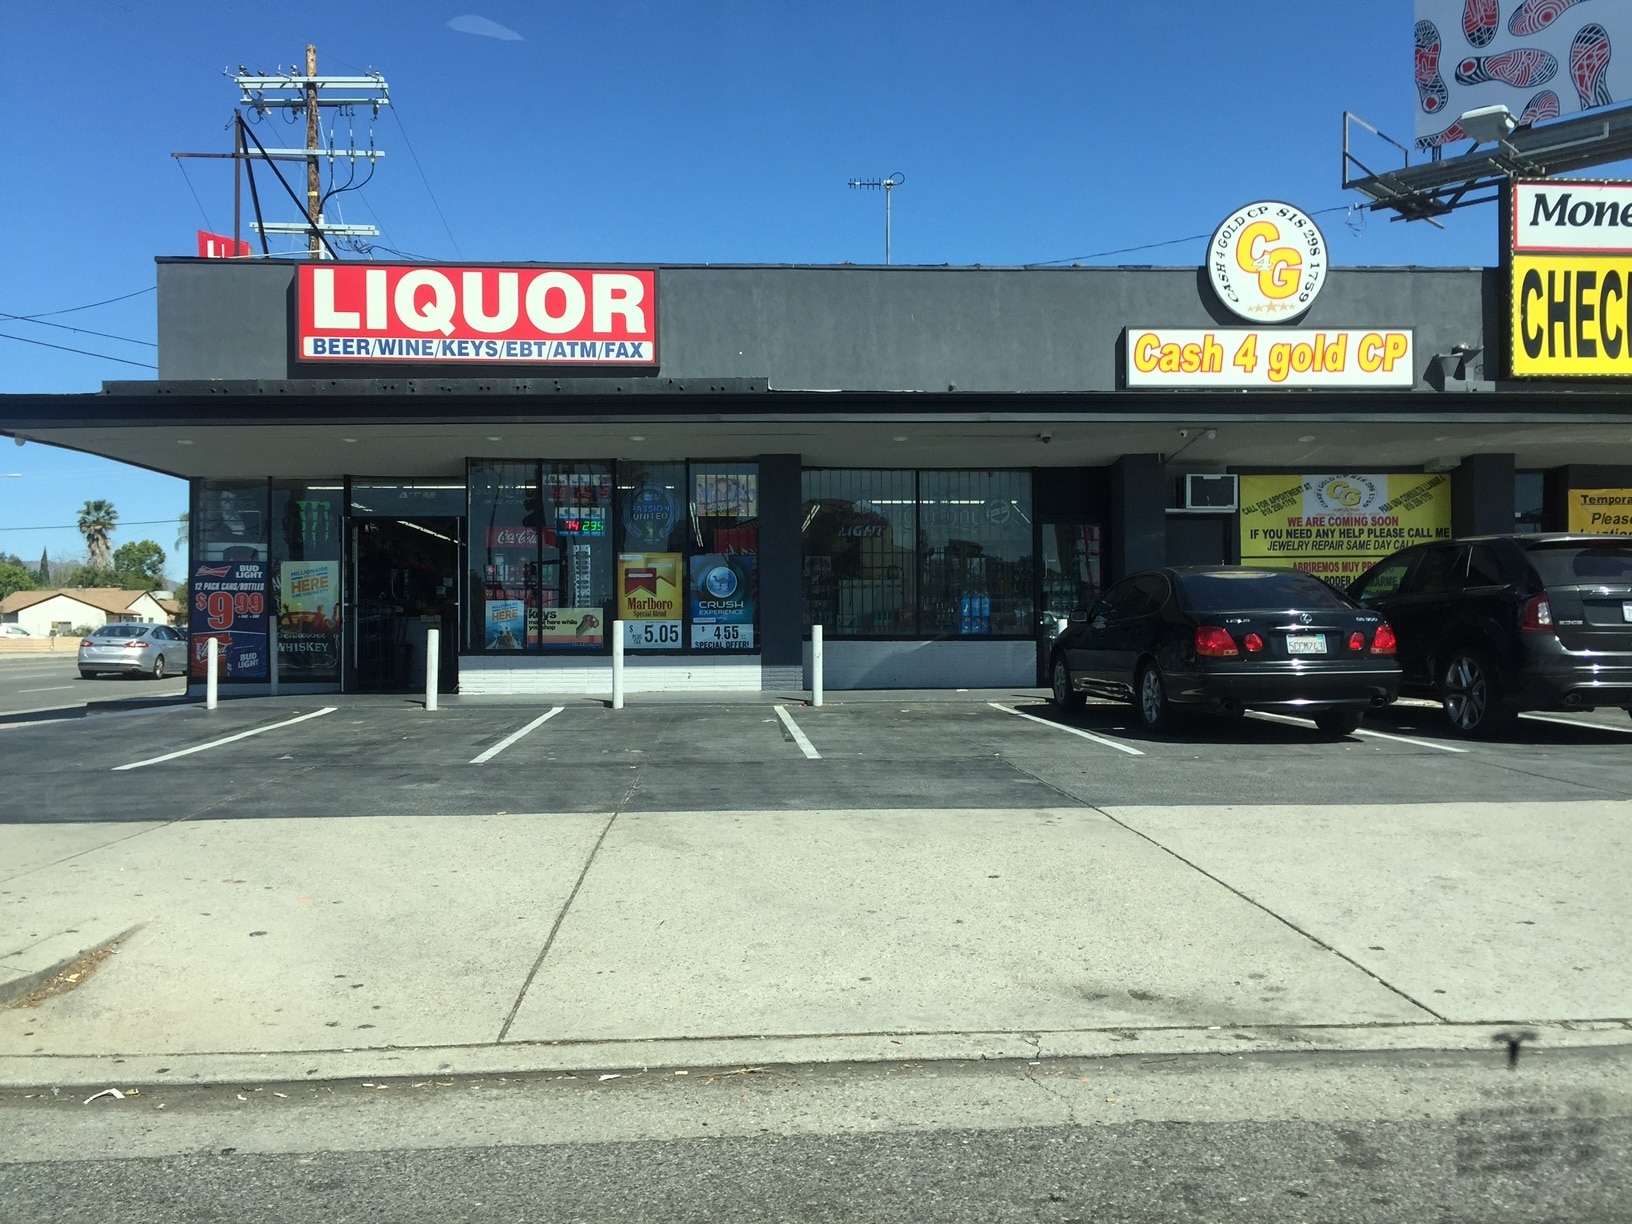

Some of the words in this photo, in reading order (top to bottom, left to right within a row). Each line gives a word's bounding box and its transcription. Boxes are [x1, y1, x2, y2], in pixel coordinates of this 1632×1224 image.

[1247, 206, 1268, 218] CP
[1218, 216, 1245, 248] GOLD
[1216, 250, 1225, 259] 4
[1216, 261, 1239, 302] CASH
[1299, 262, 1320, 302] 1759
[313, 268, 647, 336] LIQUOR
[1521, 268, 1632, 359] CHEC
[1134, 333, 1224, 372] Cash
[1233, 334, 1258, 372] 4
[1268, 333, 1348, 382] gold
[1357, 333, 1408, 372] CP
[1242, 505, 1258, 515] CALL
[1256, 500, 1270, 510] FOR
[1303, 482, 1312, 491] AT
[1287, 517, 1303, 527] WE
[1305, 516, 1325, 527] ARE
[1328, 516, 1369, 527] COMING
[1371, 516, 1399, 526] SOON
[1250, 529, 1259, 539] IF
[1262, 528, 1283, 539] YOU
[1286, 528, 1312, 539] NEED
[1315, 528, 1336, 538] ANY
[1339, 528, 1364, 538] HELP
[1367, 528, 1405, 538] PLEASE
[1408, 527, 1433, 538] CALL
[1436, 527, 1450, 538] ME
[1267, 540, 1311, 551] JEWELRY
[1311, 540, 1343, 551] REPAIR
[1346, 540, 1372, 550] SAME
[1373, 540, 1393, 550] DAY
[1341, 561, 1360, 572] MUY
[235, 571, 263, 579] LIGHT
[195, 582, 203, 591] 12
[203, 582, 220, 591] PACK
[291, 576, 329, 594] HERE
[627, 597, 673, 610] Marlboro
[699, 600, 744, 609] CRUSH
[492, 609, 519, 622] HERE
[633, 610, 652, 618] Special
[644, 624, 679, 643] 5.05
[714, 625, 739, 640] 4.55
[277, 642, 329, 652] WHISKEY
[695, 641, 724, 649] SPECIAL
[240, 653, 257, 661] BUD
[237, 659, 259, 668] LIGHT
